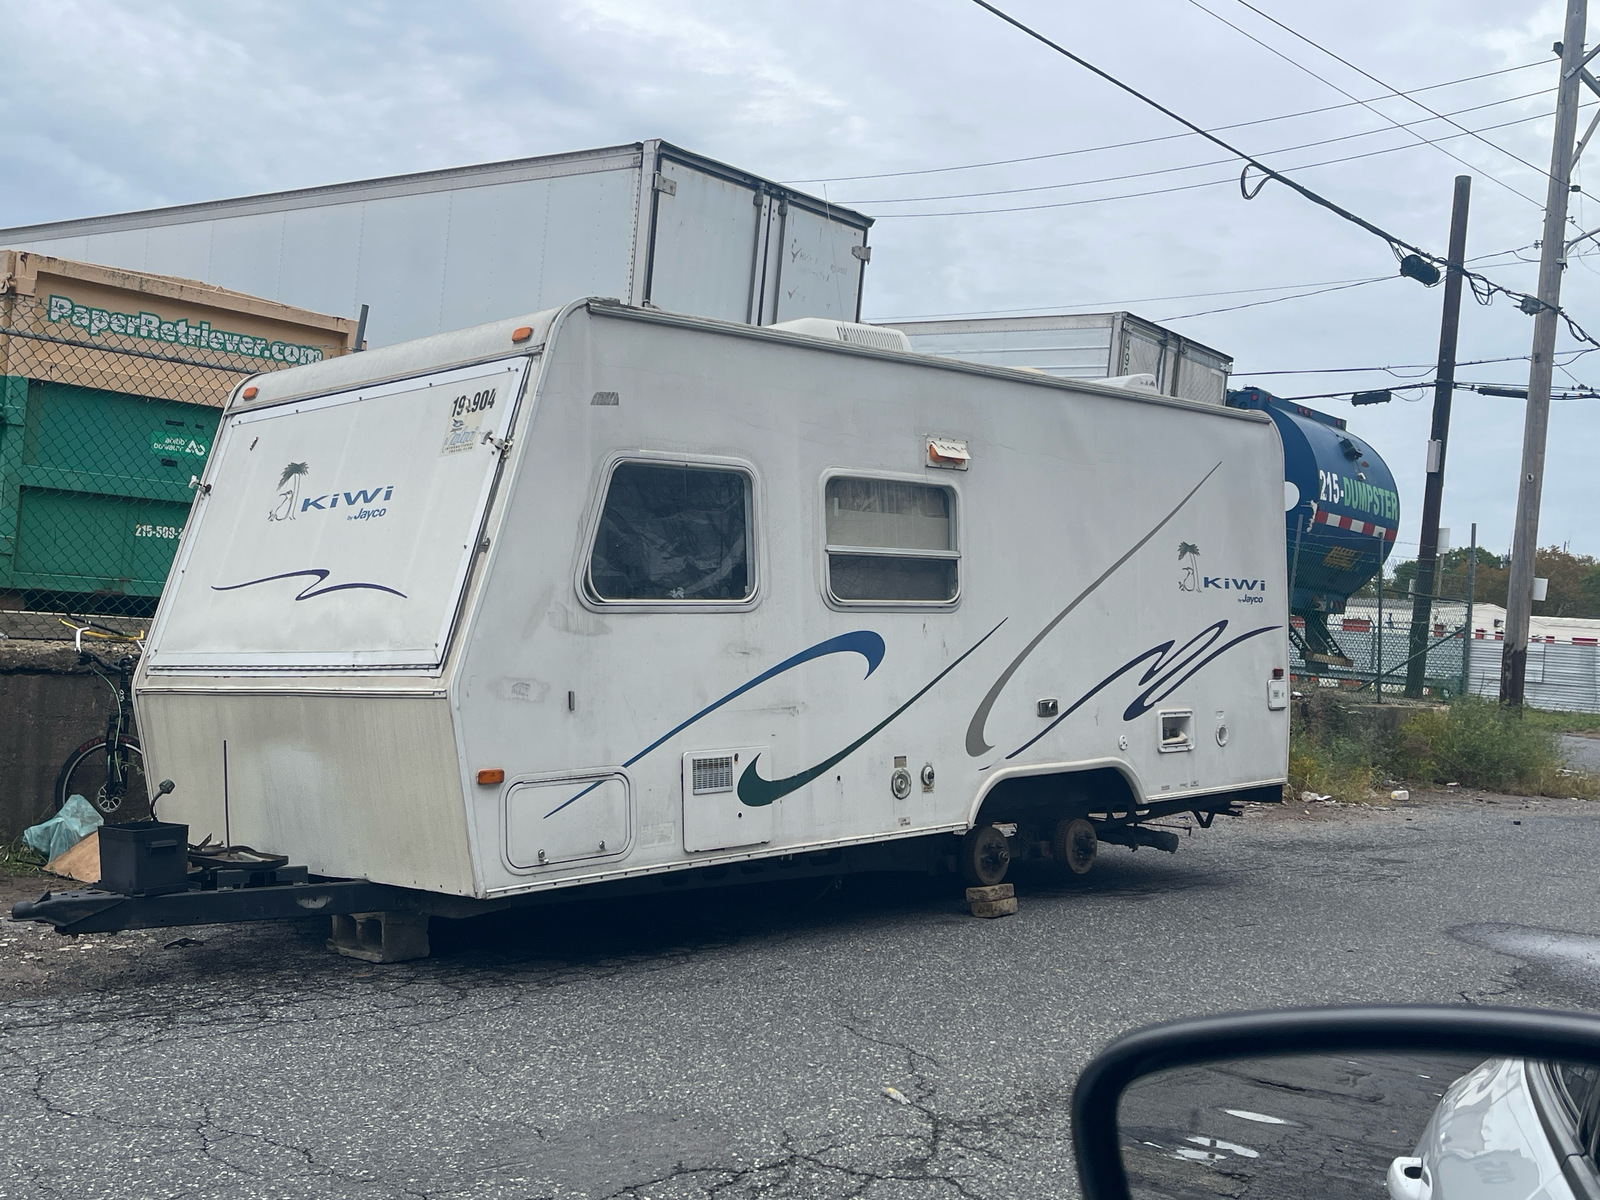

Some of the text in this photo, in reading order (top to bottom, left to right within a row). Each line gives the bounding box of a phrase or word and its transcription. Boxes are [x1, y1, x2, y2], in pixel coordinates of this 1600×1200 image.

[48, 294, 323, 365] PaperRetriever.com
[1319, 469, 1398, 521] 215-DUMPSTER
[354, 507, 387, 521] Jayco
[1242, 594, 1264, 605] Jayco
